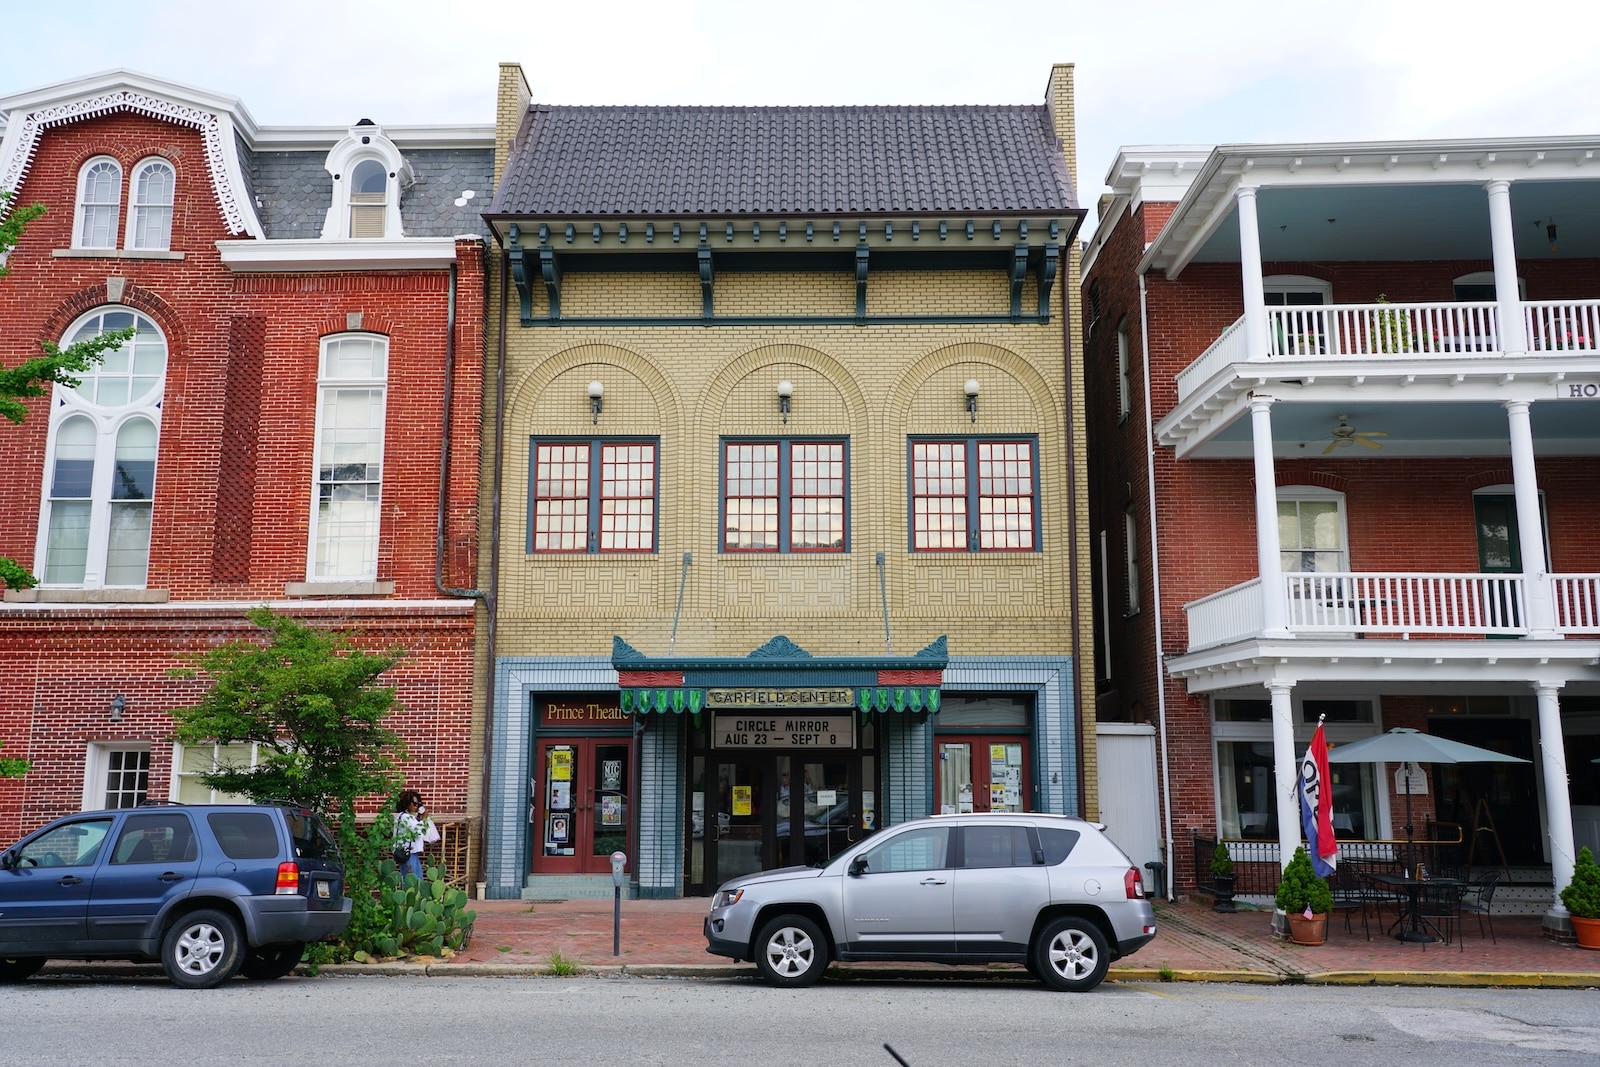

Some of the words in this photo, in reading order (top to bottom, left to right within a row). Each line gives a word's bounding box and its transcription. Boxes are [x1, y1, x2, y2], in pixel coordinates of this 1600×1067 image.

[1568, 384, 1600, 398] HO
[713, 691, 786, 703] GARFIELD
[790, 691, 848, 703] CENTER
[547, 703, 584, 720] Prince
[736, 720, 776, 732] CIRCLE
[785, 720, 829, 732] MIRROR
[725, 734, 748, 745] AUG
[754, 734, 767, 745] 23
[791, 734, 820, 745] SEPT
[830, 734, 837, 745] 8
[604, 765, 620, 774] MIC
